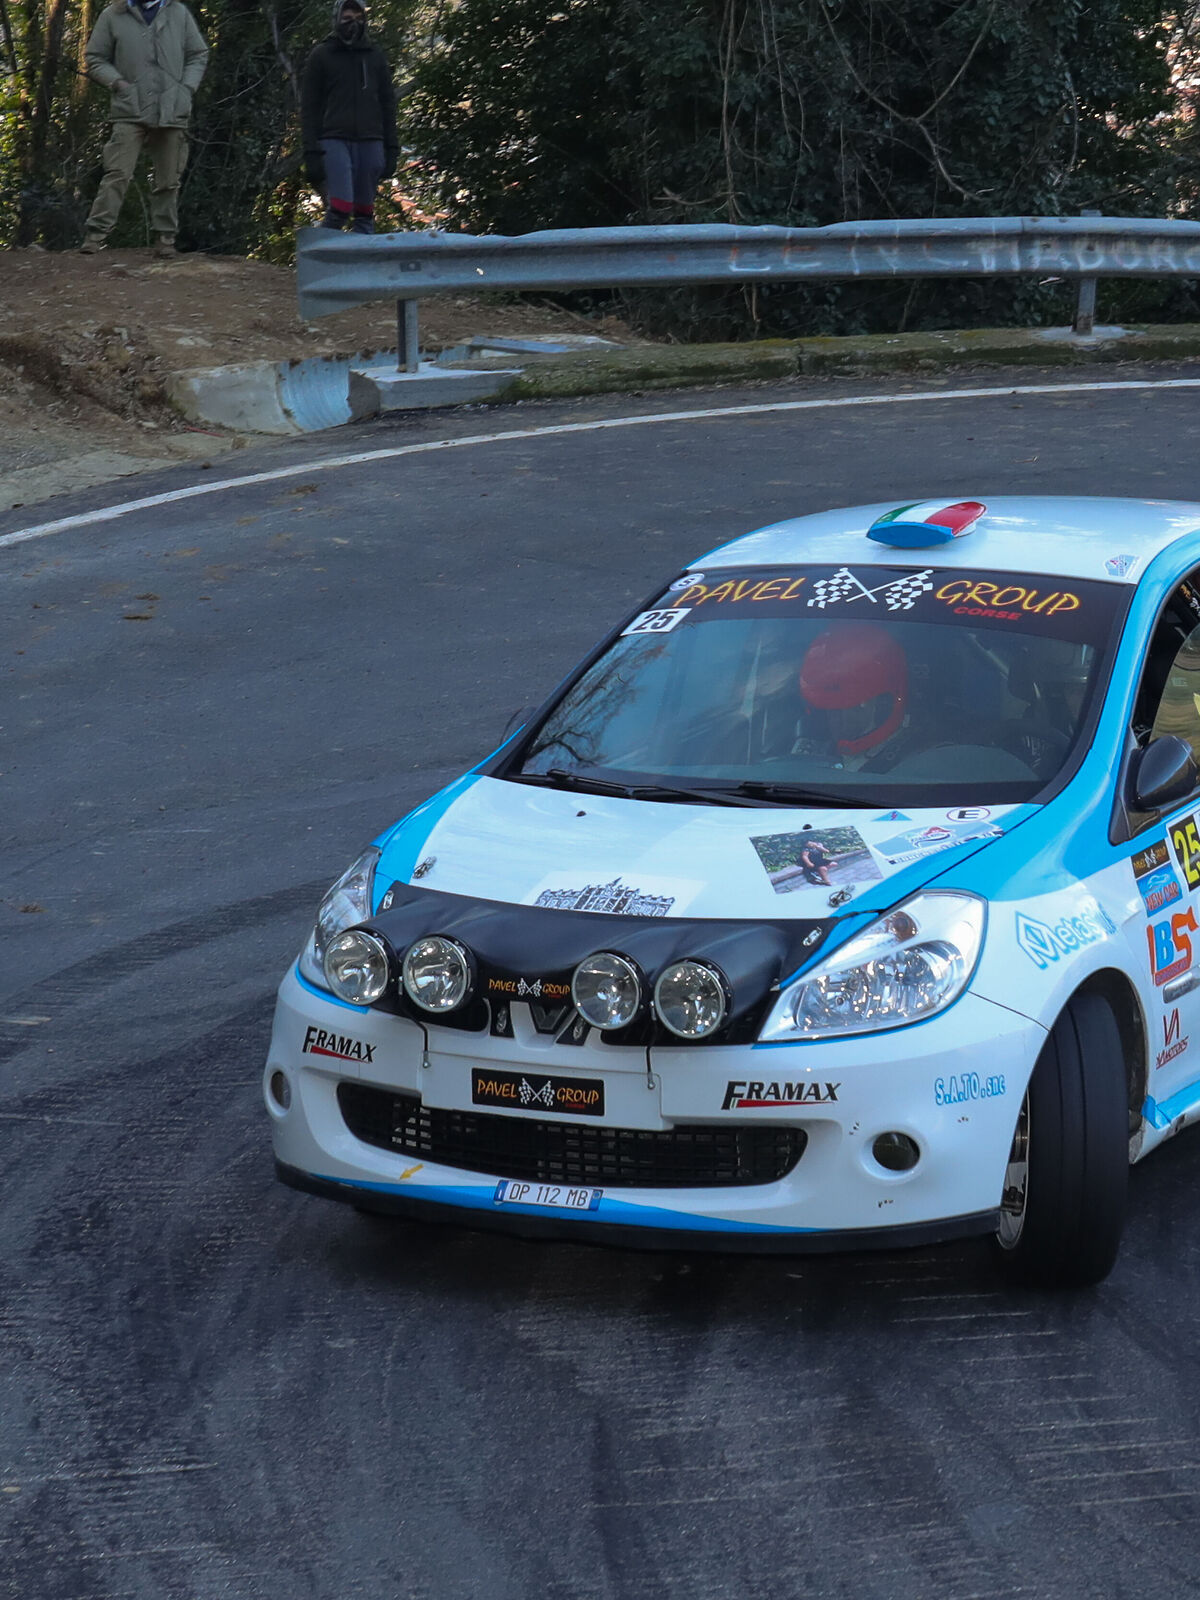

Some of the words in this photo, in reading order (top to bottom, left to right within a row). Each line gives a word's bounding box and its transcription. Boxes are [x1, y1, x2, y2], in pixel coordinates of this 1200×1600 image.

[672, 576, 806, 608] PAVEL
[935, 579, 1081, 616] GROUP
[632, 610, 680, 632] 25
[488, 978, 517, 993] PAVEL
[542, 983, 571, 995] GROUP
[302, 1025, 378, 1064] FRAMAX
[477, 1079, 517, 1099] PAVEL
[556, 1087, 600, 1105] GROUP
[720, 1080, 842, 1111] FRAMAX
[509, 1182, 531, 1201] DP
[536, 1185, 561, 1205] 112
[566, 1188, 589, 1207] MB
